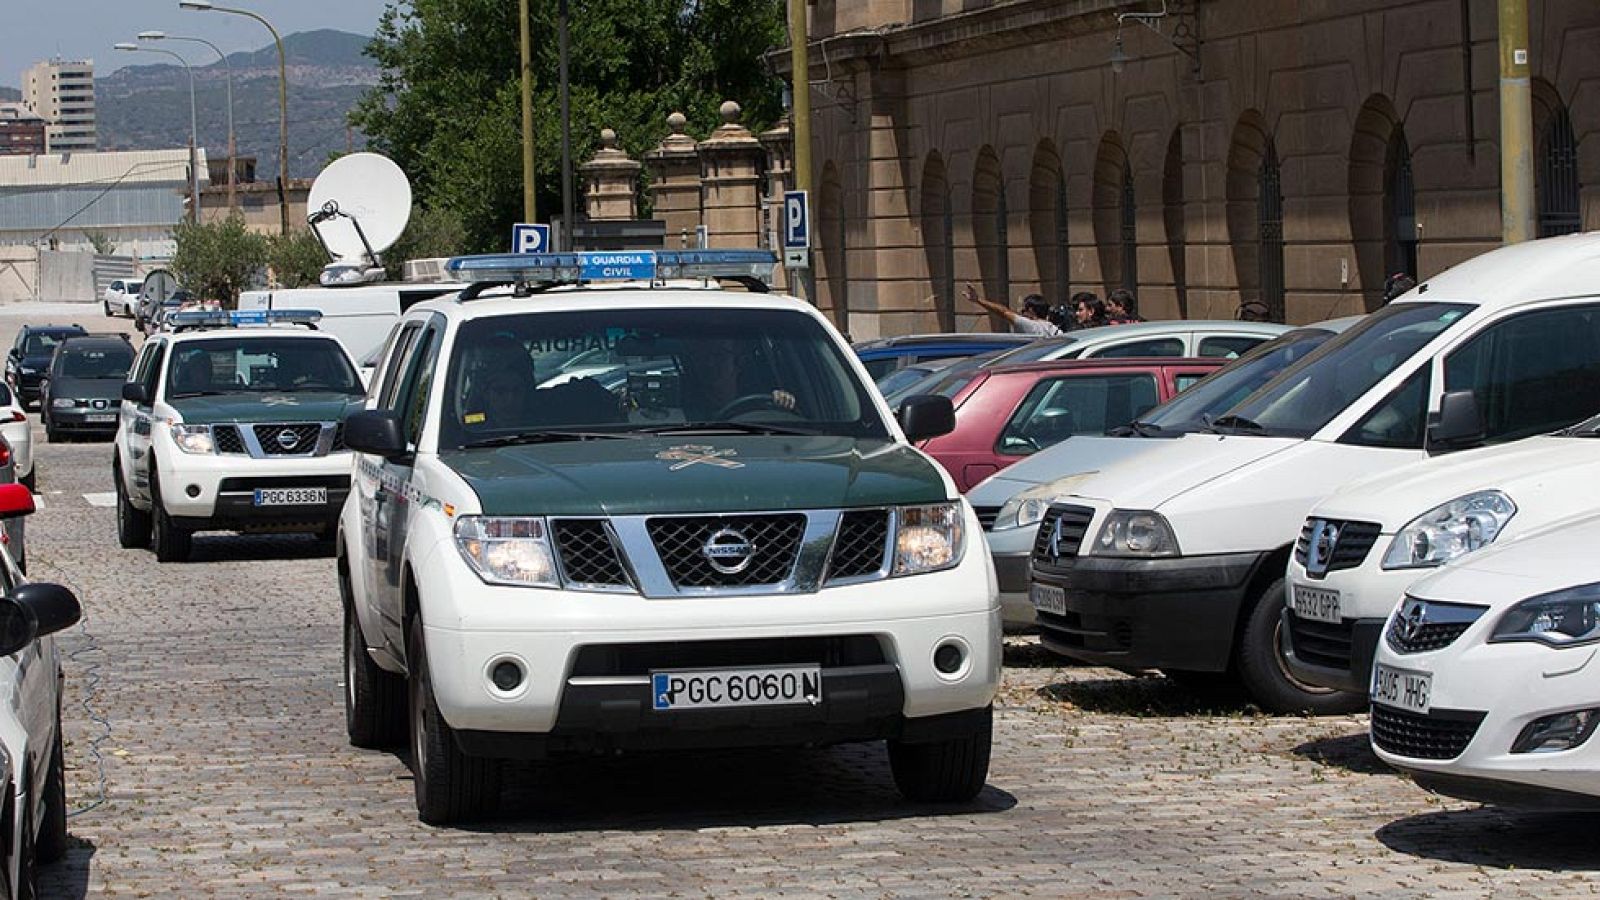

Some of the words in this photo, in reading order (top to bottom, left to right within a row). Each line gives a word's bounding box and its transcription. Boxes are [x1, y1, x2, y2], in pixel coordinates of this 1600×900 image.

[788, 198, 802, 242] P
[519, 229, 541, 254] P
[592, 255, 643, 265] GUARDIA
[603, 267, 633, 277] CIVIL
